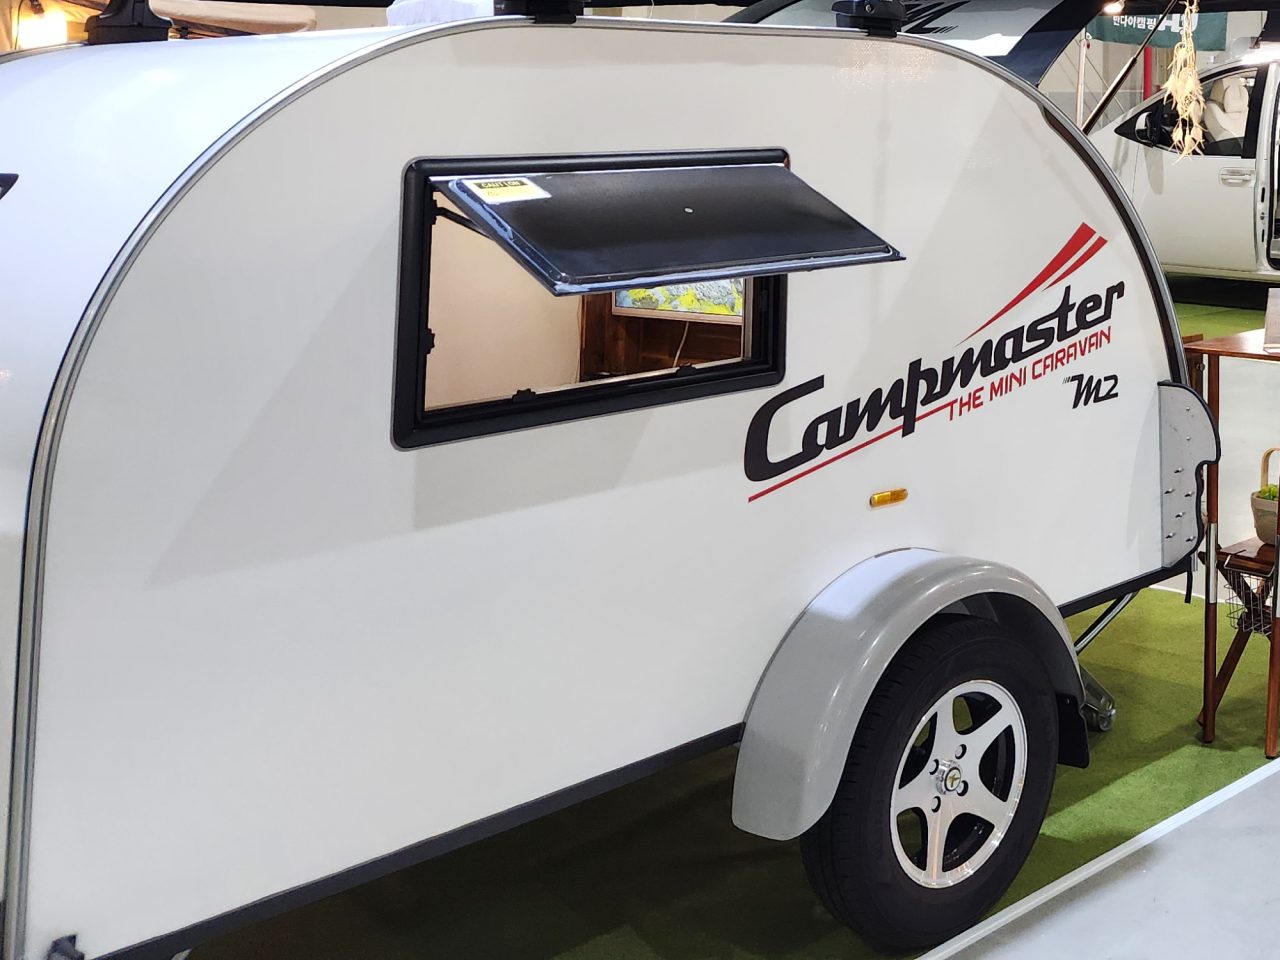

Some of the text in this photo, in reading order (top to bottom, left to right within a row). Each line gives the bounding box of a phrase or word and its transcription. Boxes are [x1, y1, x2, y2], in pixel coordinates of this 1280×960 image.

[744, 280, 1125, 482] Campmaster
[950, 325, 1112, 422] THE MINI CARAVAN
